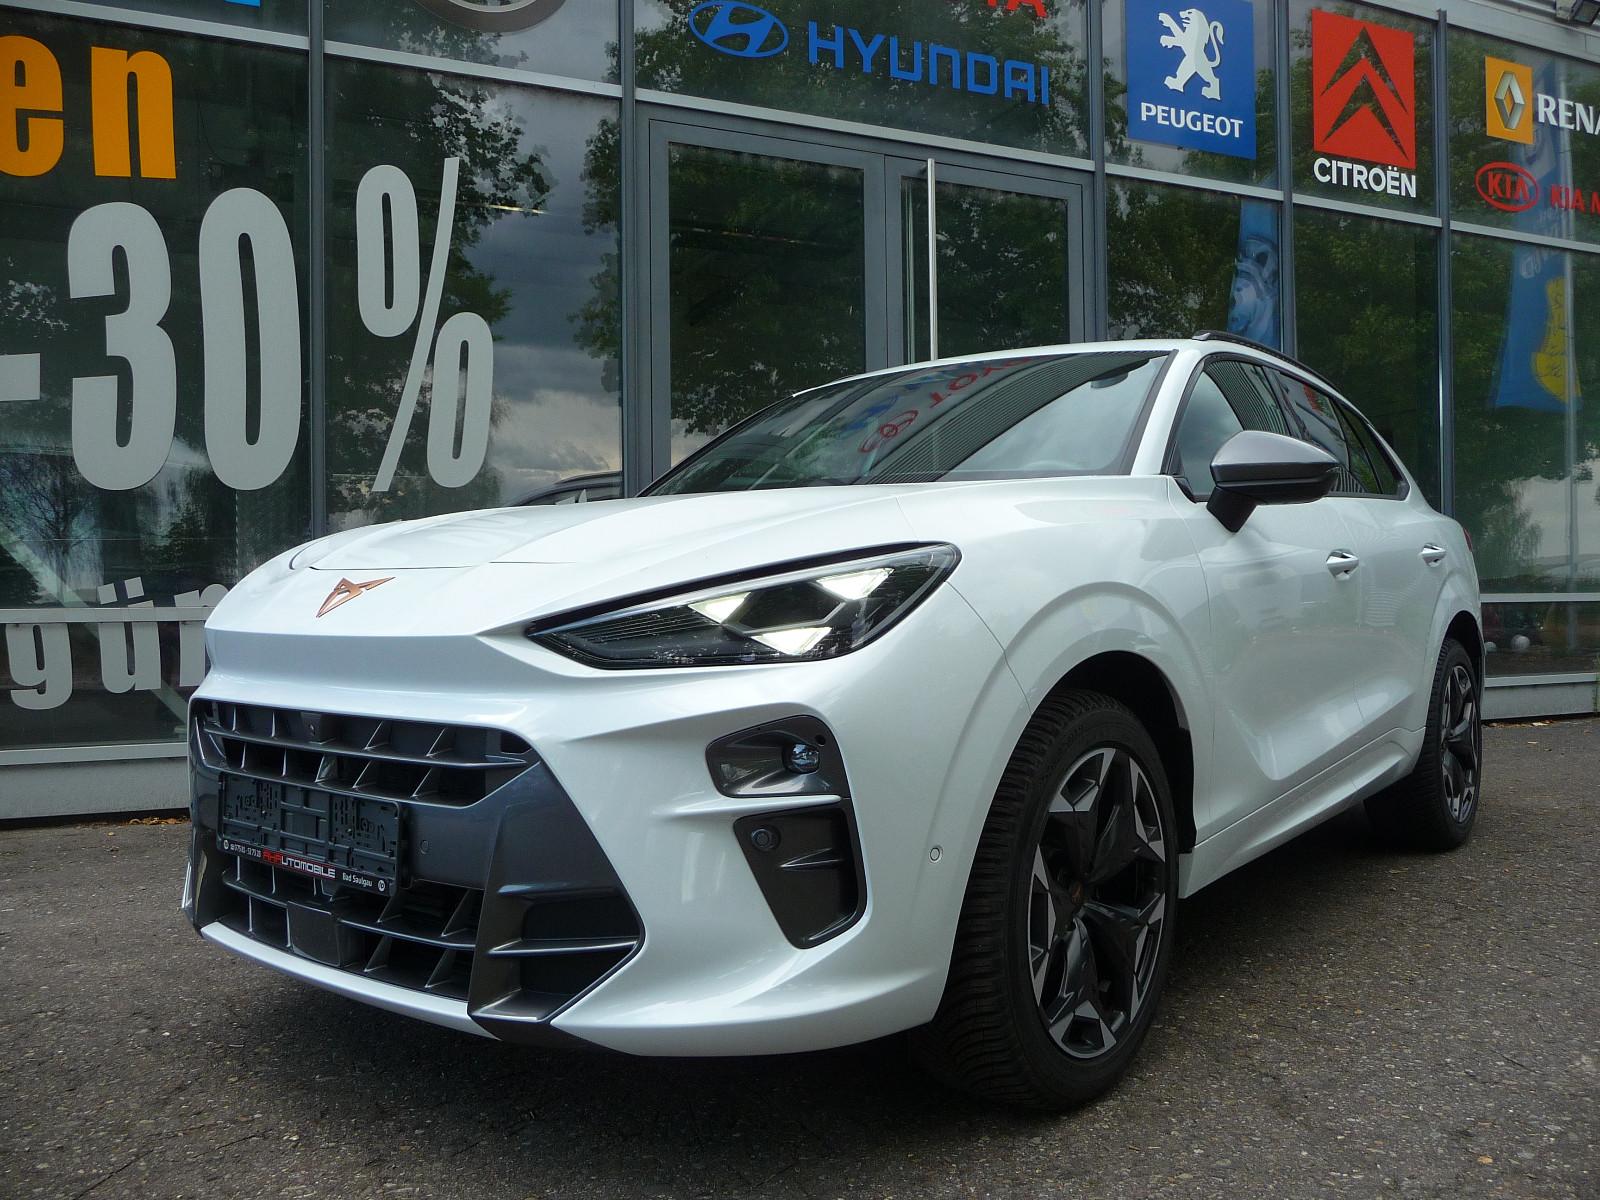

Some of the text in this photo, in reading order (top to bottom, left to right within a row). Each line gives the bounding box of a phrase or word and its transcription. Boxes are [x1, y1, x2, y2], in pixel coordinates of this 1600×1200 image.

[809, 21, 1049, 105] HYUNDAI
[1141, 102, 1243, 138] PEUGEOT
[1537, 93, 1600, 135] REN
[1314, 157, 1417, 198] CITROËN
[1488, 171, 1529, 201] KIA
[1550, 184, 1586, 214] KIA
